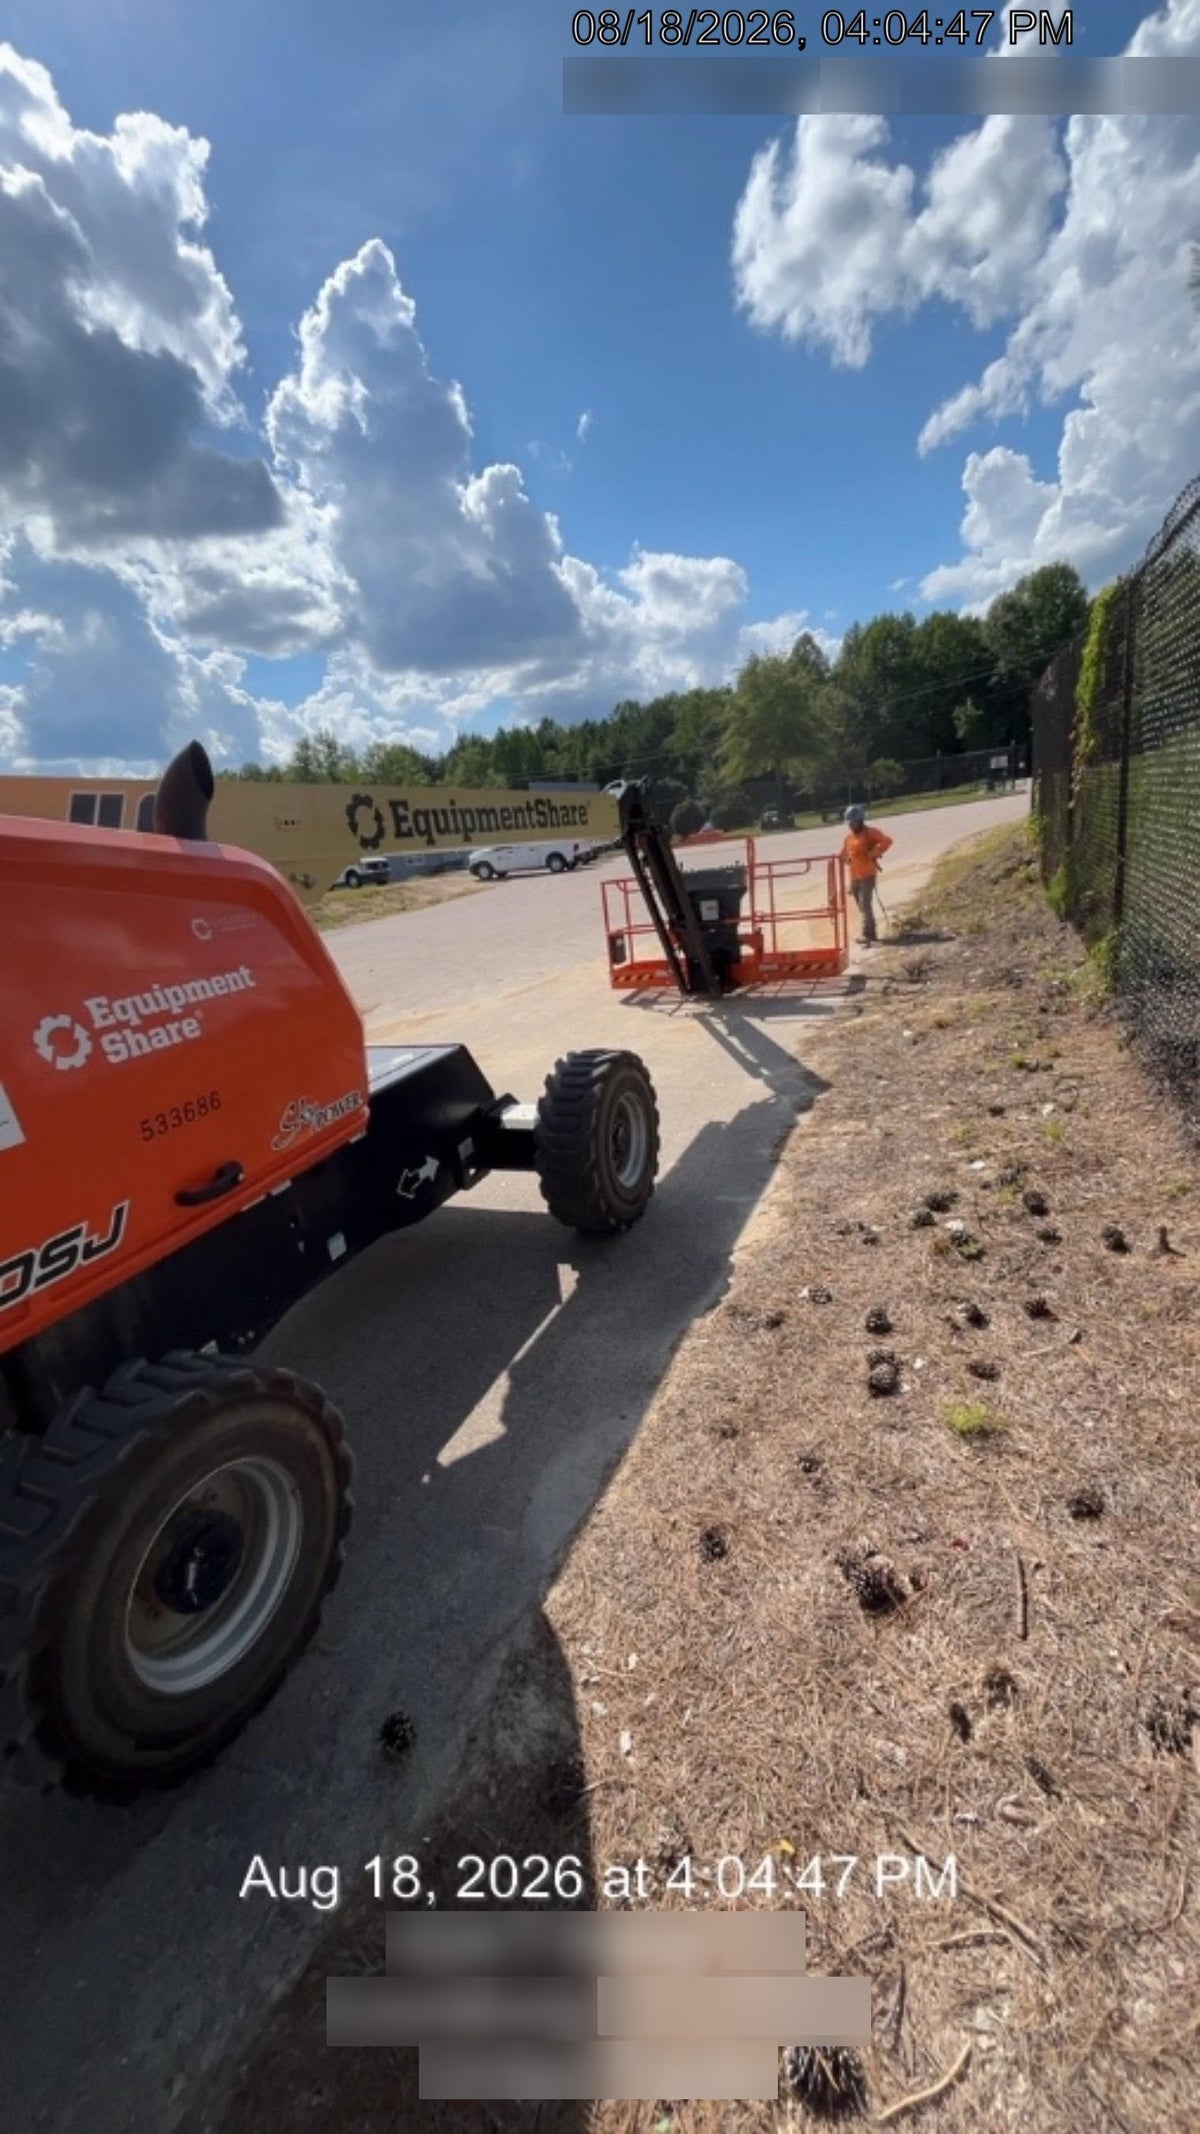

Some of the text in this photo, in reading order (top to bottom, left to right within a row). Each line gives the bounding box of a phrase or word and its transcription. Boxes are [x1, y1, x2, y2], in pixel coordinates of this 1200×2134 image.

[84, 965, 256, 1029] Equipment
[101, 1017, 201, 1064] Share
[140, 1090, 221, 1141] 533686
